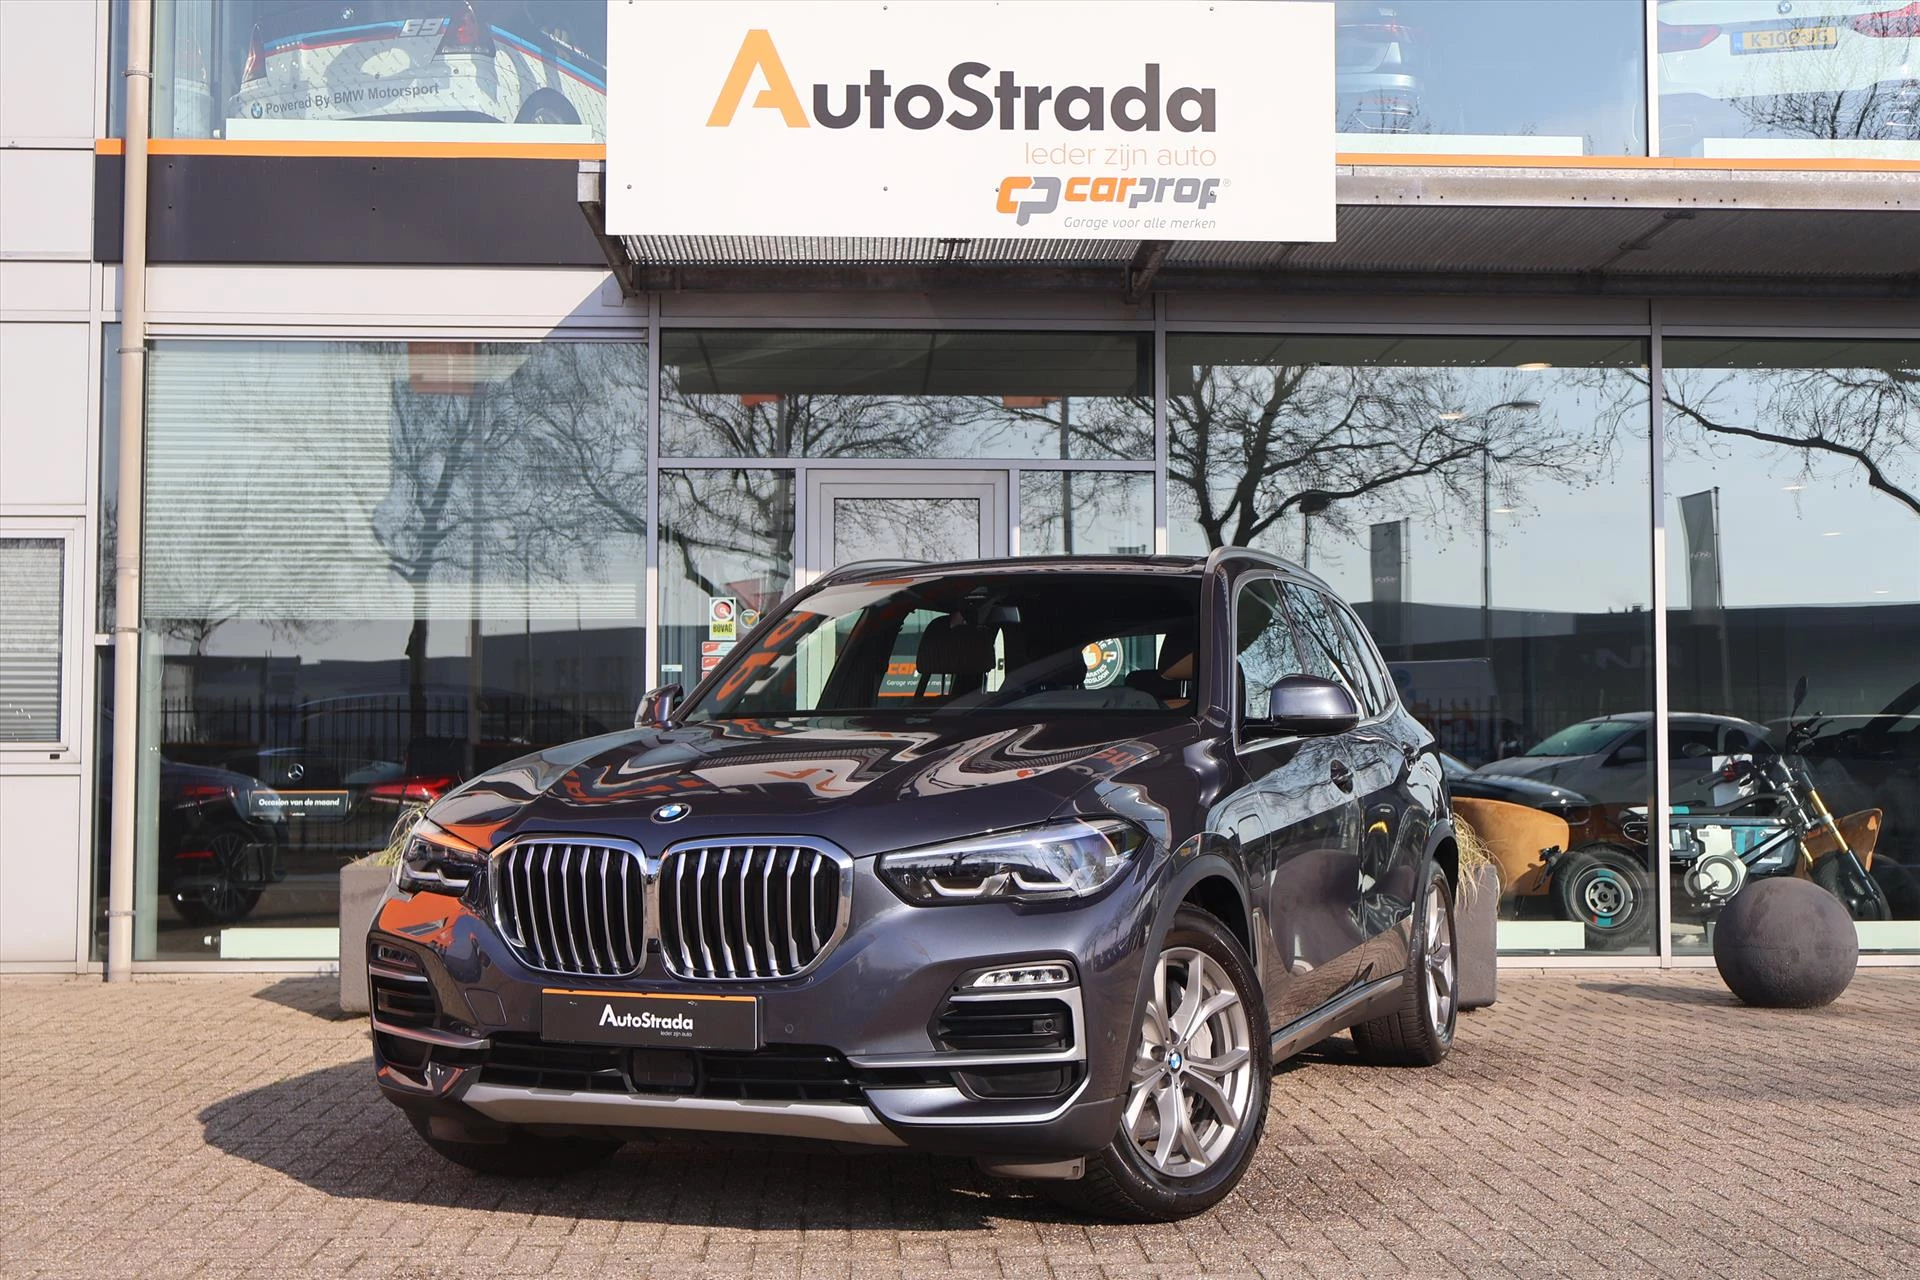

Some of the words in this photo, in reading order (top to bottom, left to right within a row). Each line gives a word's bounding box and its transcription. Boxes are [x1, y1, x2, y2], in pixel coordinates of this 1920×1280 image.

[706, 29, 1216, 133] AutoStrada
[266, 98, 312, 114] Powered
[315, 94, 330, 109] By
[334, 90, 364, 104] BMW
[368, 83, 439, 100] Motorsport
[1025, 142, 1096, 165] Ieder
[1104, 144, 1148, 171] zijn
[1157, 145, 1217, 167] auto
[1064, 217, 1109, 231] Garage
[1112, 219, 1141, 229] voor
[1144, 217, 1167, 229] alle
[1170, 217, 1216, 230] merken
[713, 624, 733, 632] BOVAG
[258, 798, 289, 806] Occasion
[304, 797, 313, 806] de
[314, 797, 340, 806] maand
[599, 1003, 694, 1030] AutoStrada
